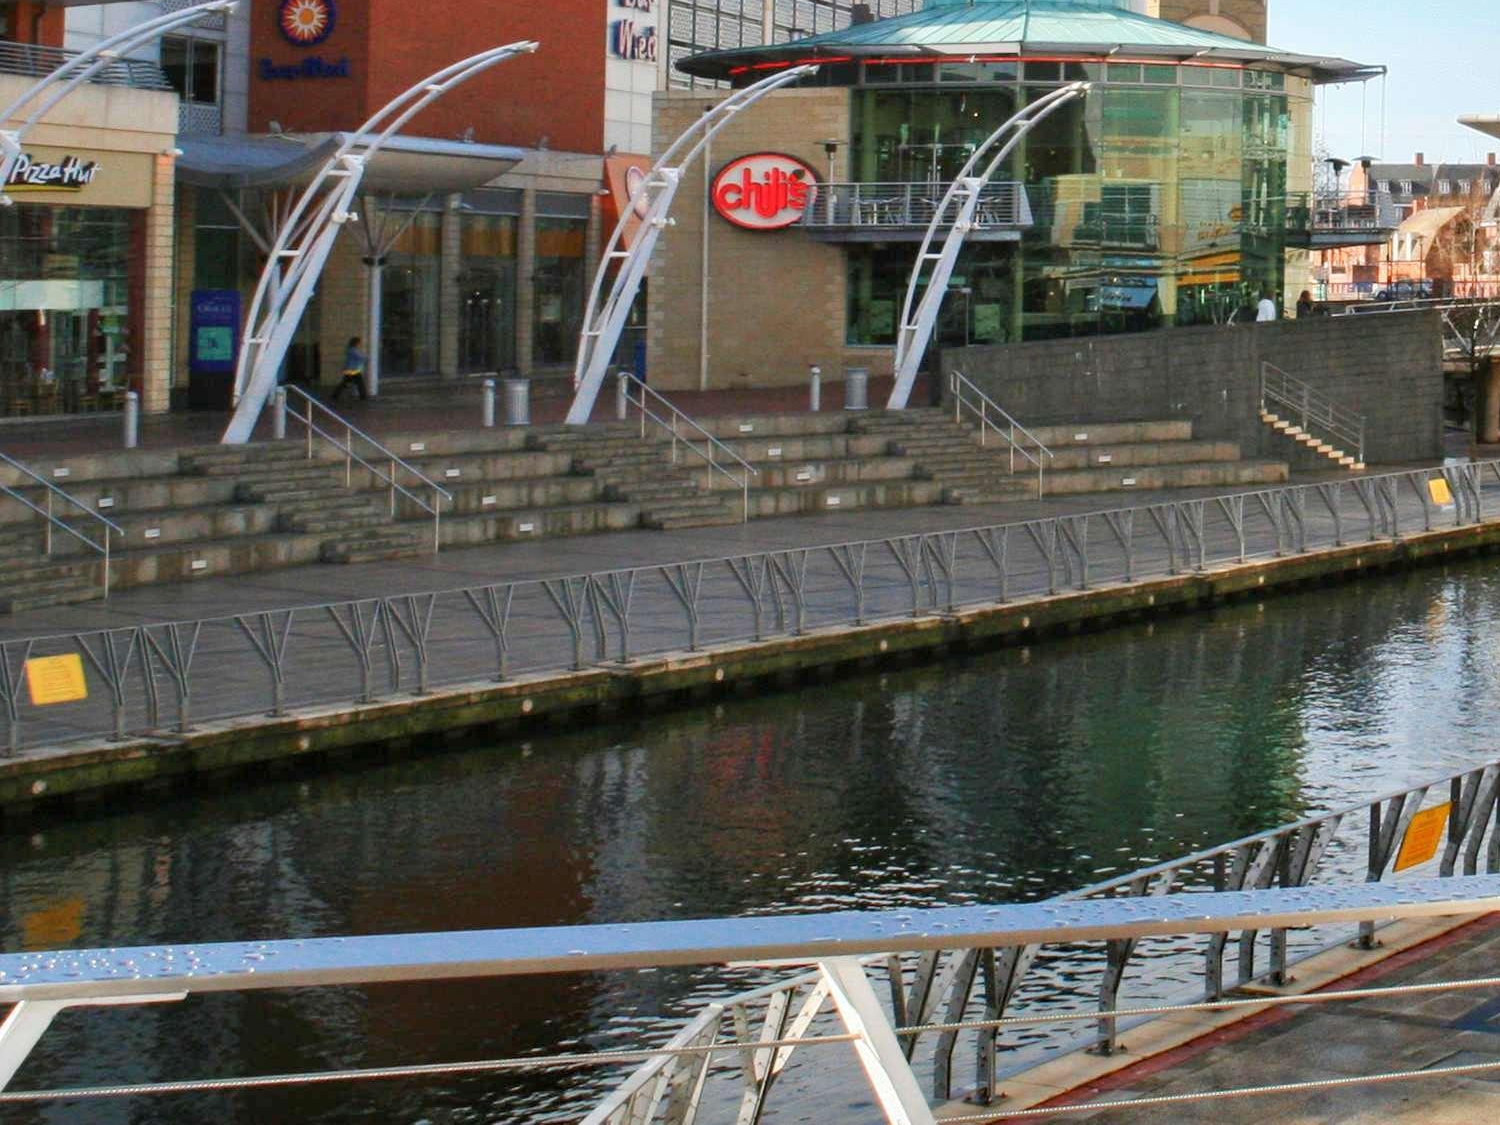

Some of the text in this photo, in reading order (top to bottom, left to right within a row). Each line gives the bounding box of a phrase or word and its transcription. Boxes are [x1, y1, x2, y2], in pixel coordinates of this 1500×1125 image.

[617, 21, 657, 62] Med
[10, 154, 102, 184] Pizza Hut
[718, 167, 809, 219] chili's
